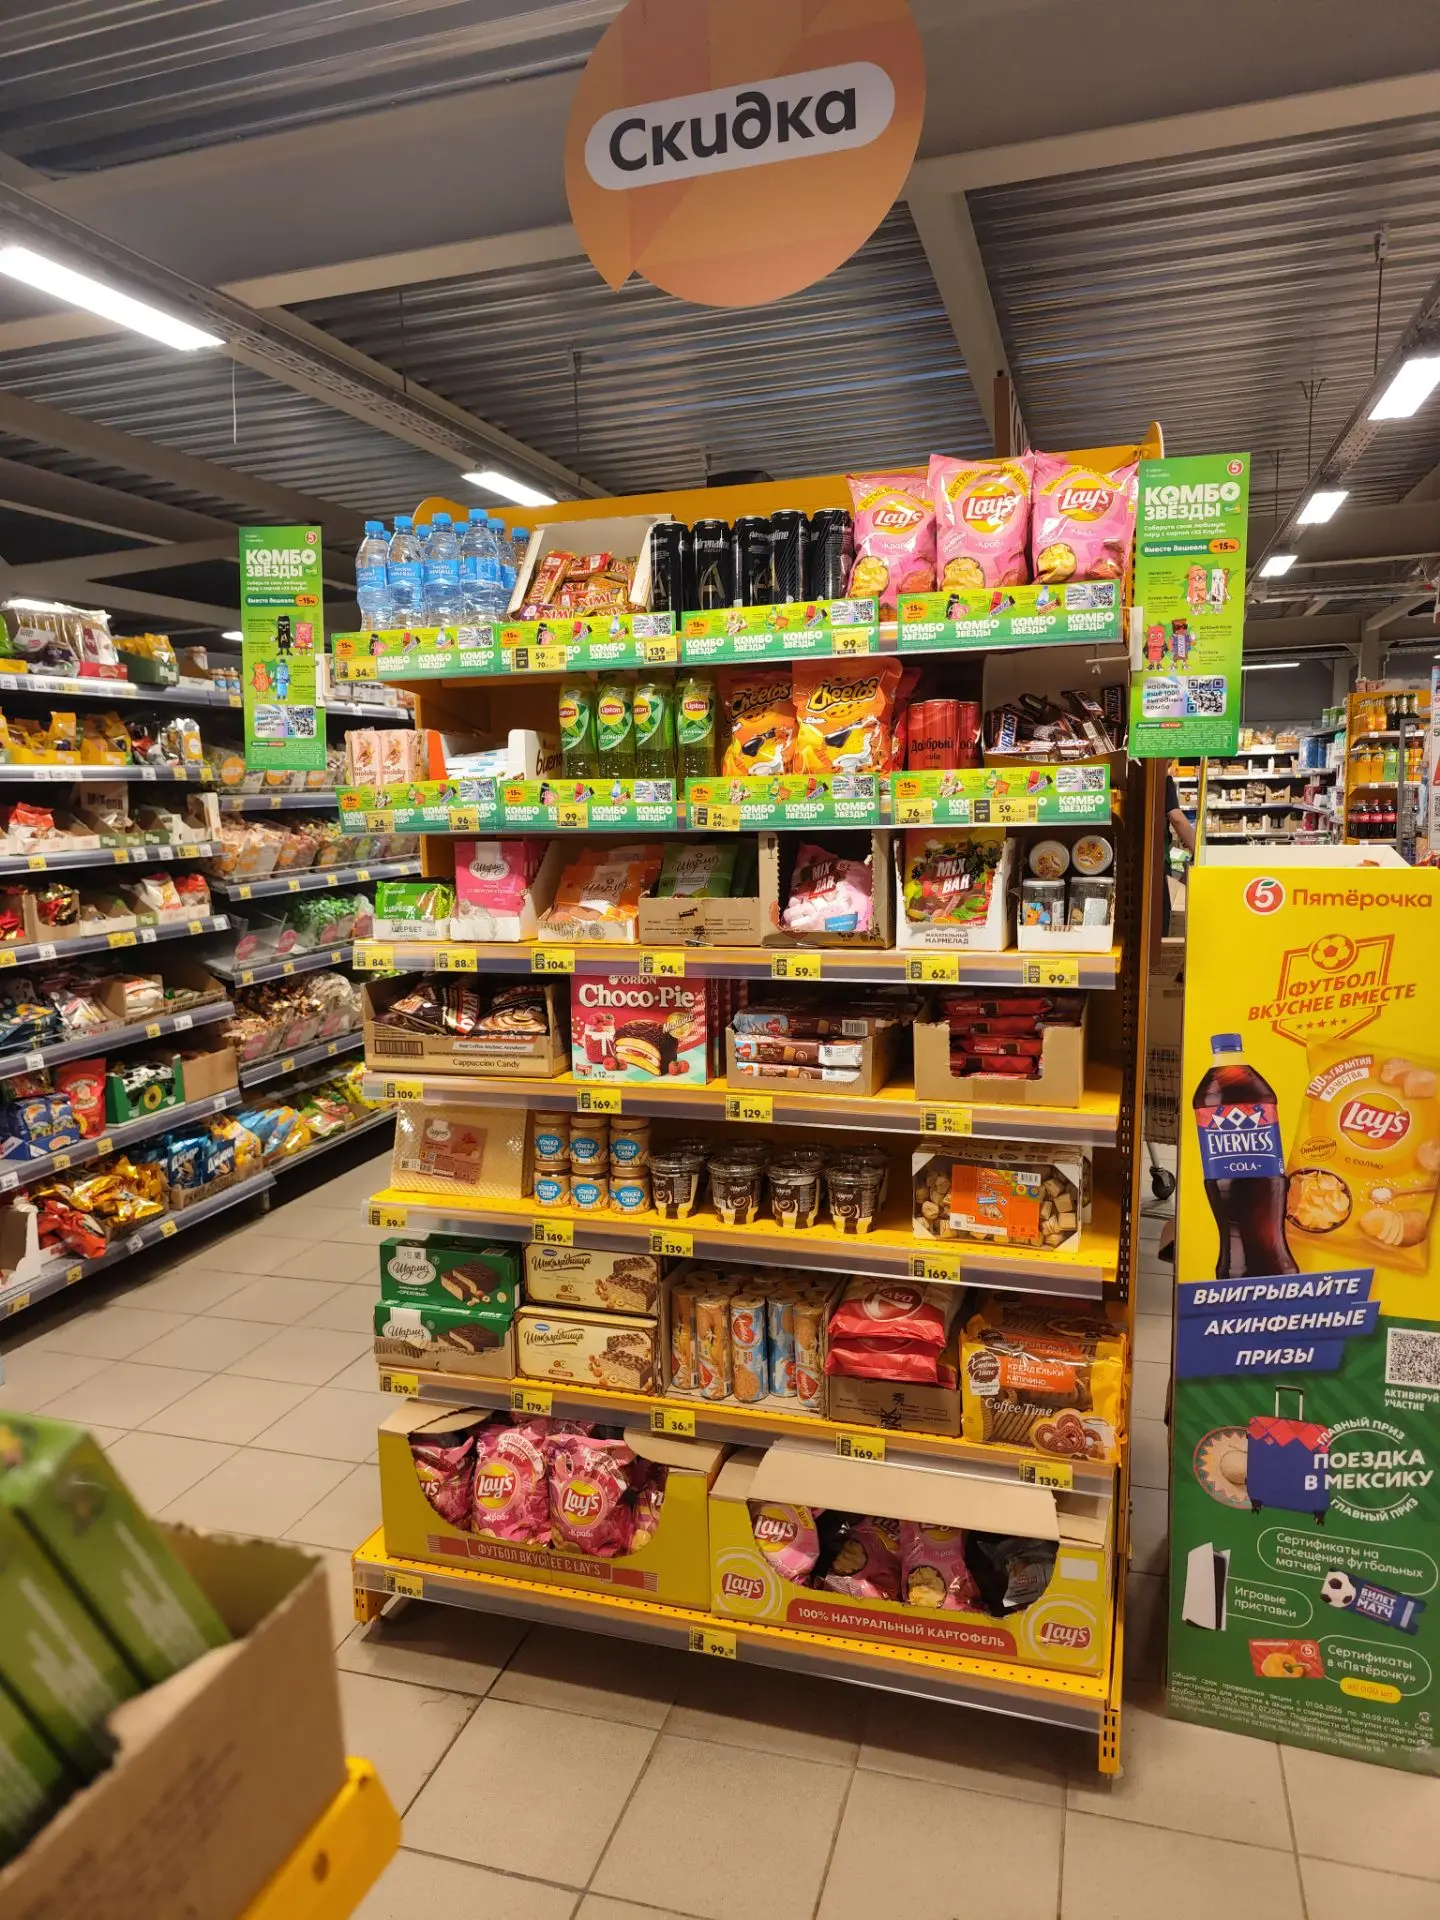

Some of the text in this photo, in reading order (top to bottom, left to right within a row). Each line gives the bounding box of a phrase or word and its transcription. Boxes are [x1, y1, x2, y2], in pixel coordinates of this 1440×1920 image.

[609, 87, 857, 172] Скидка
[1061, 487, 1109, 511] Lay's
[1145, 482, 1241, 505] КОМБО
[966, 491, 1020, 524] Lay's
[875, 509, 922, 528] Lay's
[1174, 544, 1207, 552] дешевле
[245, 548, 317, 566] КОМБО
[1010, 616, 1056, 628] КОМБО
[1067, 612, 1114, 624] КОМБО
[902, 622, 944, 633] КОМБО
[955, 619, 1000, 631] КОМБО
[733, 634, 772, 644] КОМБО
[783, 630, 823, 641] КОМБО
[686, 638, 724, 648] КОМБО
[843, 640, 856, 649] 99
[459, 651, 494, 661] КОМБО
[650, 646, 665, 656] 139
[355, 668, 367, 677] 34
[806, 677, 880, 713] Cheetos
[601, 706, 621, 714] Lipton
[685, 702, 706, 710] Lipton
[1059, 795, 1104, 805] КОМБО
[505, 806, 539, 815] КОМБО
[591, 806, 627, 815] КОМБО
[636, 806, 672, 815] КОМБО
[785, 803, 824, 812] КОМБО
[834, 801, 875, 812] КОМБО
[998, 805, 1011, 813] 59
[565, 813, 576, 821] 99
[906, 809, 920, 818] 76
[375, 819, 384, 827] 24
[457, 817, 469, 825] 96
[813, 862, 832, 879] MIX
[936, 858, 966, 877] MIX
[815, 879, 834, 893] BAR
[942, 874, 970, 894] BAR
[1255, 881, 1432, 910] 5 Пятёрочка
[372, 959, 383, 967] 84
[455, 960, 467, 968] 88
[547, 961, 563, 969] 104
[660, 965, 674, 974] 94
[795, 968, 808, 976] 59
[932, 970, 945, 978] 62
[621, 976, 657, 985] ORION
[1049, 974, 1064, 984] 99
[1288, 971, 1376, 997] ФУТБОЛ
[1247, 984, 1417, 1021] ВКУСНЕЕ ВМЕСТЕ
[453, 1059, 520, 1070] Cappuccino Candy
[1331, 1055, 1372, 1079] ГАРАНТИЯ
[1326, 1071, 1362, 1096] КАЧЕСТВА
[397, 1091, 413, 1099] 109
[593, 1101, 610, 1109] 169
[743, 1109, 761, 1119] 129
[1343, 1103, 1408, 1138] Lay's
[1208, 1131, 1274, 1154] EVERVESS
[1229, 1162, 1257, 1171] COLA
[1353, 1160, 1384, 1169] солью
[387, 1220, 398, 1228] 59
[546, 1233, 562, 1242] 149
[665, 1245, 682, 1254] 139
[531, 1254, 592, 1271] Шоколадница
[927, 1269, 947, 1279] 169
[1193, 1276, 1360, 1305] ВЫИГРЫВАЙТЕ
[1204, 1309, 1366, 1336] АКИНФЕННЫЕ
[523, 1328, 585, 1346] Шоколадница
[1235, 1347, 1315, 1366] ПРИЗЫ
[1007, 1363, 1064, 1377] КРЕНДЕЛЬКИ
[394, 1384, 409, 1394] 129
[1384, 1389, 1440, 1403] АКТИВИРУЙ
[526, 1402, 542, 1412] 179
[984, 1397, 1053, 1417] Coffee Time
[1384, 1399, 1425, 1411] УЧАСТИЕ
[671, 1421, 684, 1430] 36
[1316, 1416, 1405, 1445] ГЛАВНЫЙ ПРИЗ
[854, 1449, 872, 1459] 169
[1314, 1449, 1426, 1470] ПОЕЗДКА
[478, 1474, 514, 1498] Lay's
[1039, 1477, 1059, 1487] 139
[1304, 1470, 1434, 1491] В МЕКСИКУ
[564, 1490, 600, 1517] Lay's
[1330, 1497, 1420, 1522] ГЛАВНЫЙ ПРИЗ
[568, 1528, 594, 1538] «Краб»
[754, 1515, 798, 1540] Lay's
[1276, 1532, 1379, 1559] Сертификаты на
[478, 1544, 601, 1576] ФУТБОЛ ВКУСНЕЕ С LAY'S
[1275, 1558, 1321, 1573] матчей
[1276, 1545, 1423, 1578] посещение футбольных
[396, 1584, 413, 1595] 189
[724, 1572, 764, 1598] Lay's
[1234, 1586, 1287, 1607] Игровые
[1360, 1587, 1397, 1606] БИЛЕТ
[1234, 1599, 1297, 1619] приставки
[1355, 1599, 1393, 1619] МАТЧ
[799, 1607, 1005, 1647] 100% НАТУРАЛЬНЫЙ КАРТОФЕЛЬ
[1045, 1622, 1090, 1648] Lay's
[711, 1645, 726, 1655] 99
[1327, 1644, 1413, 1670] Сертификаты
[1337, 1661, 1416, 1683] «Пятёрочку»
